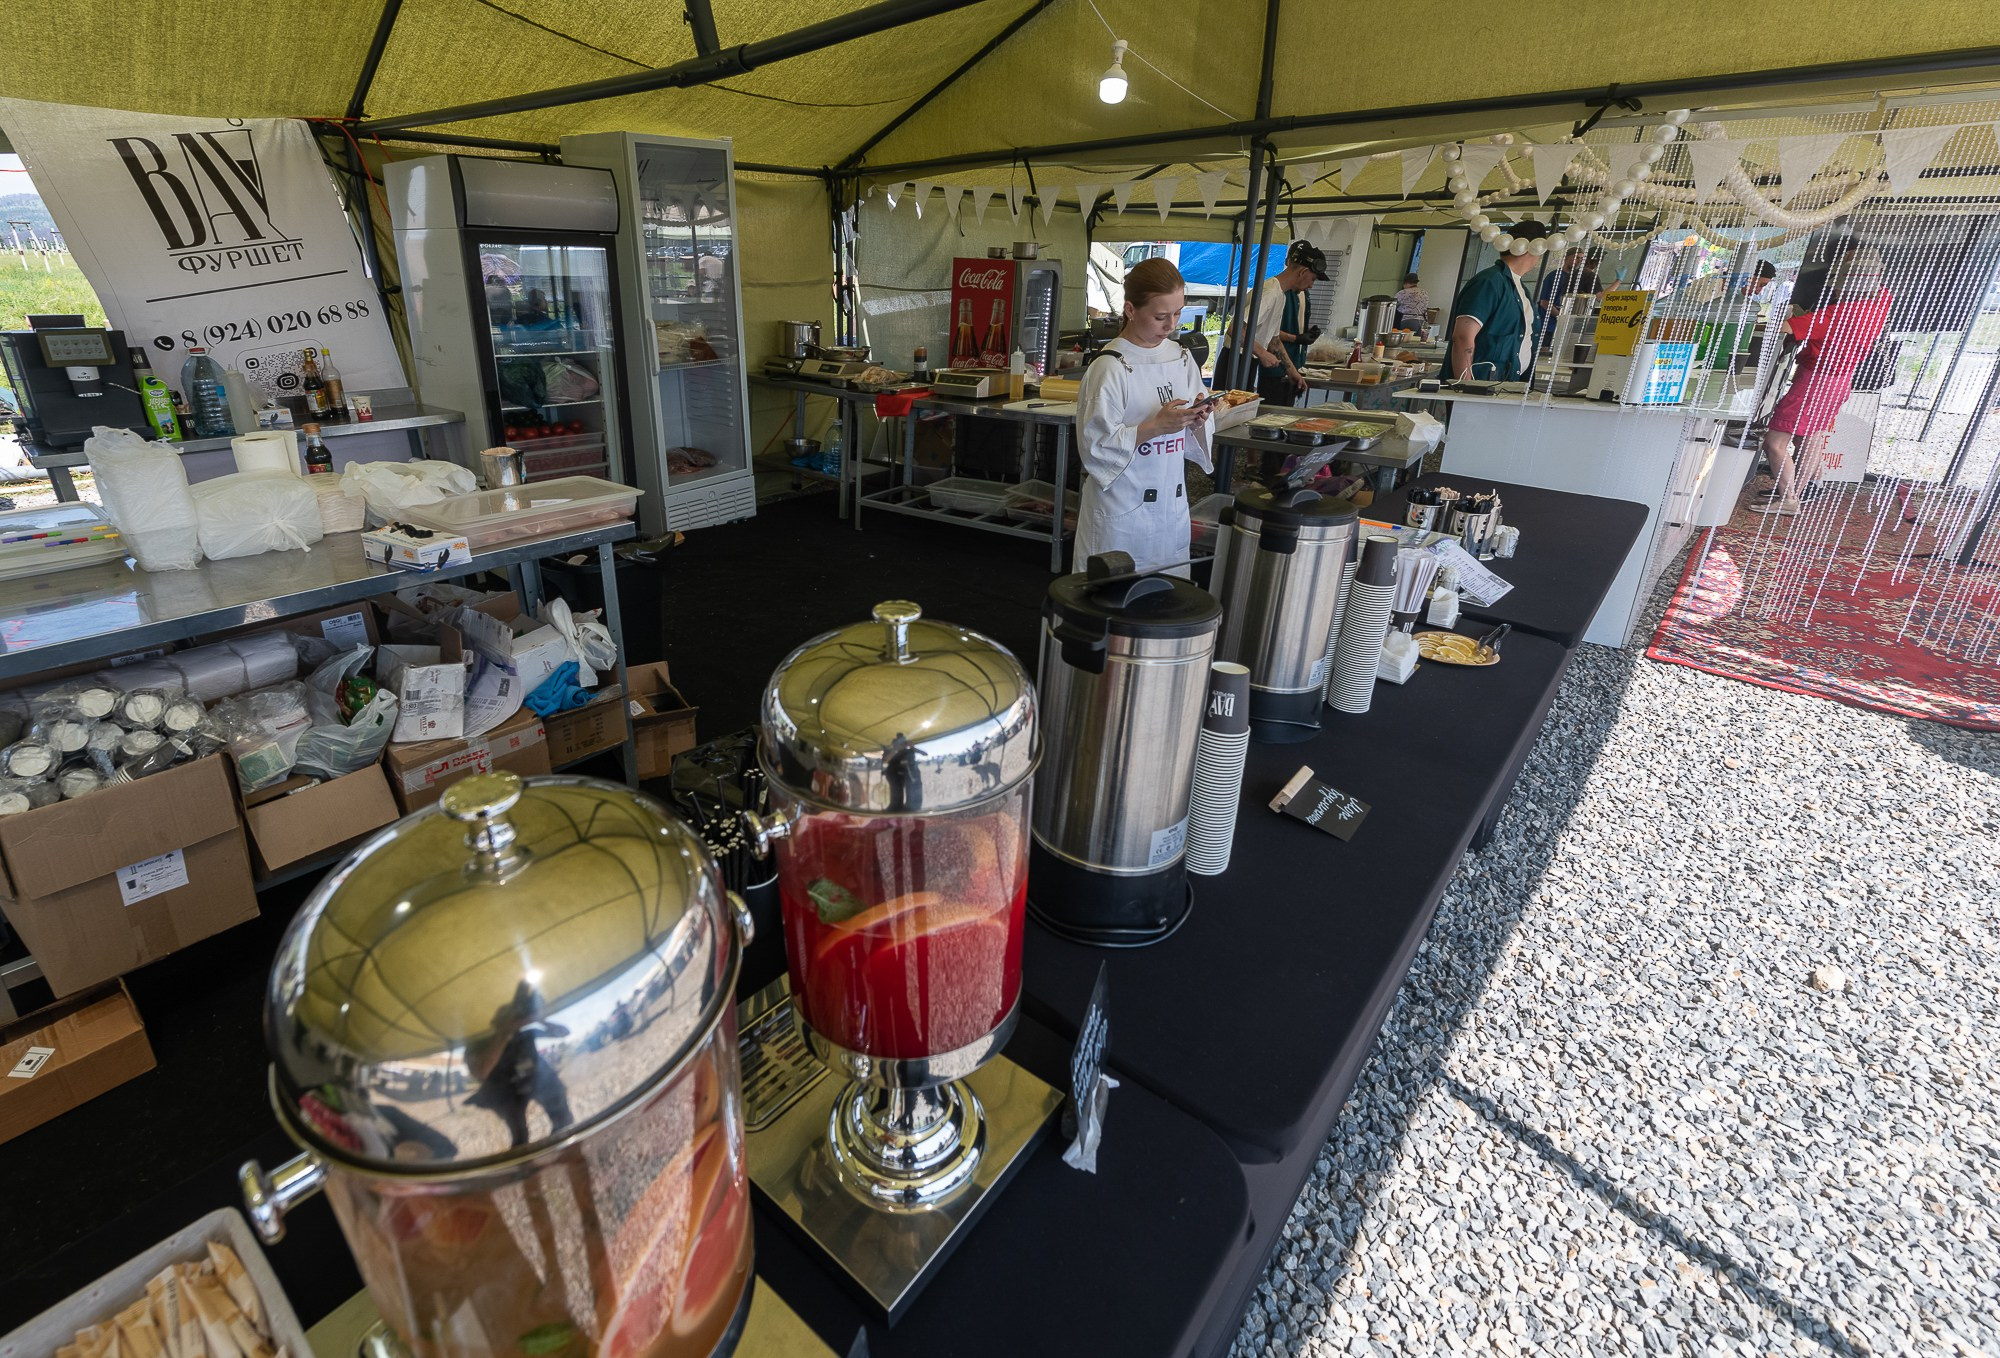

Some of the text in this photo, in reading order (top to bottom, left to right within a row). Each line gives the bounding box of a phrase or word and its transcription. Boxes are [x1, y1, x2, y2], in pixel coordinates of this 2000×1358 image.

[178, 243, 304, 275] ФУРШЕТ
[959, 268, 1008, 290] Coca-Cola
[1606, 294, 1620, 302] Бери
[181, 300, 370, 348] 8 (924) 020 68 88
[1600, 314, 1629, 324] Яндекс
[452, 749, 485, 763] ПАКЕТ
[453, 752, 491, 767] МАРКЕТ
